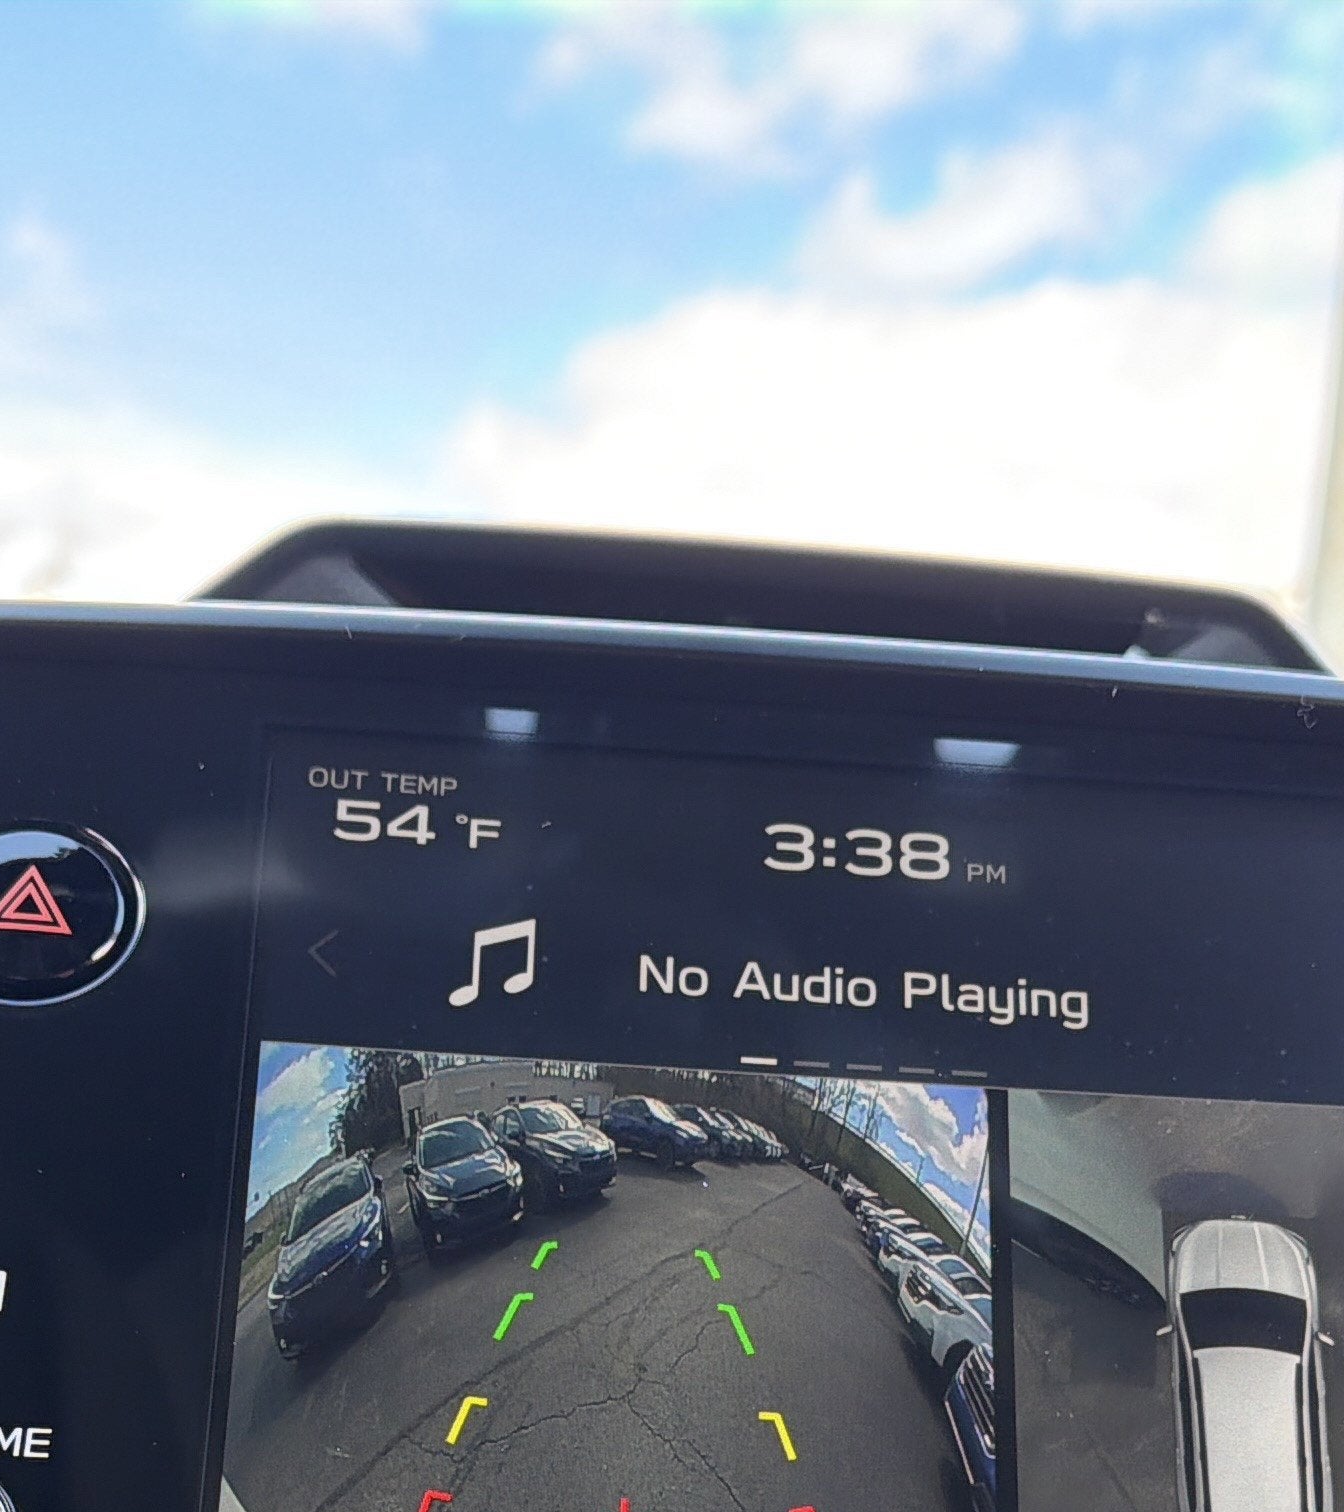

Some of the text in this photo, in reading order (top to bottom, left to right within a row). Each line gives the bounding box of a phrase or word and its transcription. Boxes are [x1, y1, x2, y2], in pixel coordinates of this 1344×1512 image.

[308, 766, 458, 796] OUT TEMP
[333, 799, 436, 845] 54
[764, 823, 1007, 884] 3:38 PM
[639, 954, 1089, 1030] No Audio Playing
